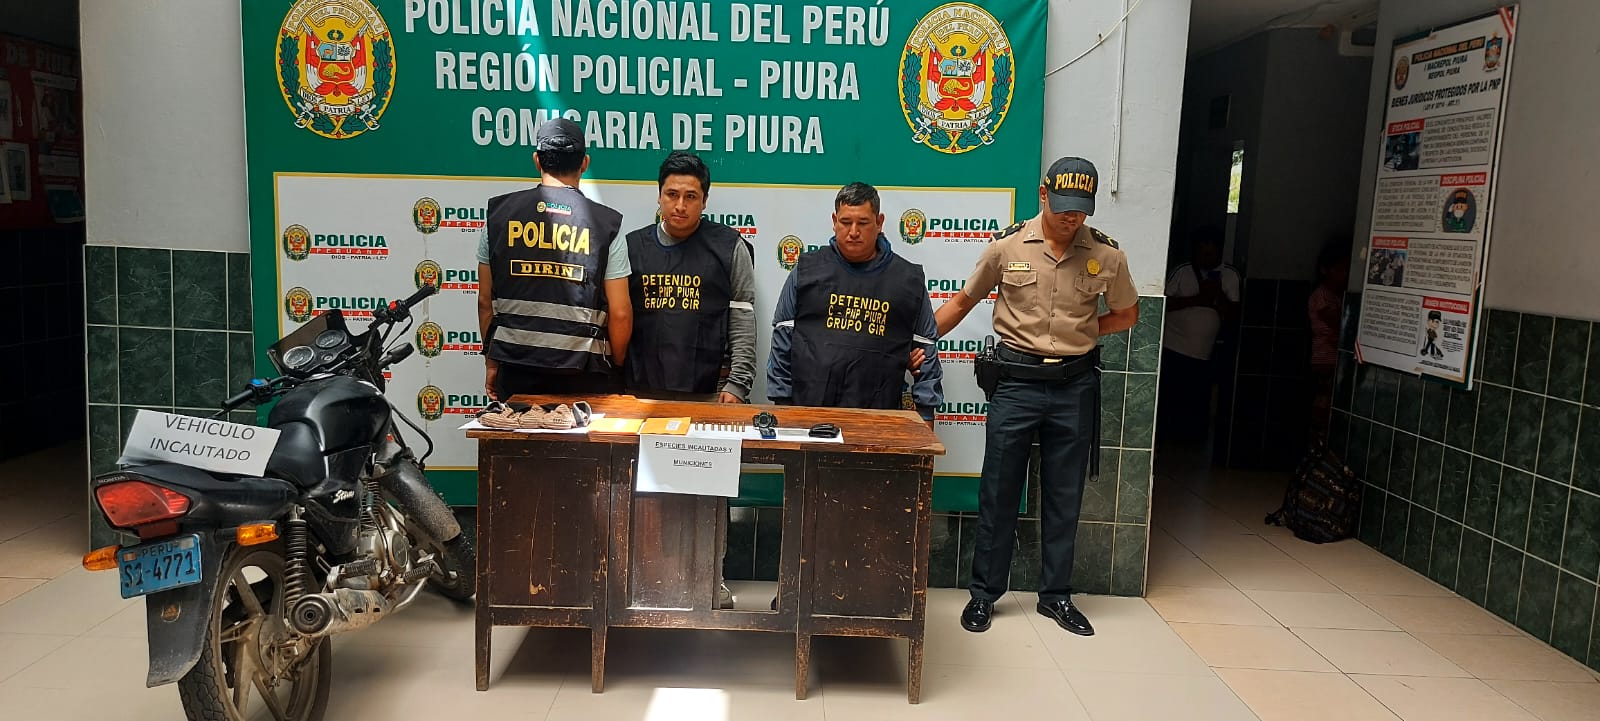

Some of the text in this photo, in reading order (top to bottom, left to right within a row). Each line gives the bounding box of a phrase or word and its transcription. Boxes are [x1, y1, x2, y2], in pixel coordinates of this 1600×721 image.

[551, 0, 718, 41] NACIONAL
[730, 3, 791, 43] DEL
[803, 0, 890, 46] PERÚ
[435, 44, 559, 92] REGIÓN
[573, 54, 723, 97] POLICIAL
[760, 60, 860, 100] PIURA
[1468, 81, 1480, 94] POR
[1480, 80, 1488, 93] LA
[472, 107, 825, 154] COMARIA DE PIURA
[941, 121, 968, 129] PATRIA
[1055, 173, 1094, 193] POLICIA
[930, 219, 999, 231] POLICIA
[314, 234, 387, 248] POLICIA
[520, 263, 574, 278] DIRIN
[642, 274, 701, 287] DETENIDO
[677, 286, 700, 299] PIURA
[645, 297, 700, 310] GRUPO GIR
[830, 293, 890, 314] DETENIDO
[864, 310, 887, 325] PIURA
[826, 317, 885, 336] GRUPO GIR
[165, 414, 256, 440] VEHICULO
[150, 437, 251, 461] INCAUTADO
[655, 441, 686, 450] ESPECIES
[687, 444, 727, 452] INCAUTADAS
[142, 543, 174, 557] PERU
